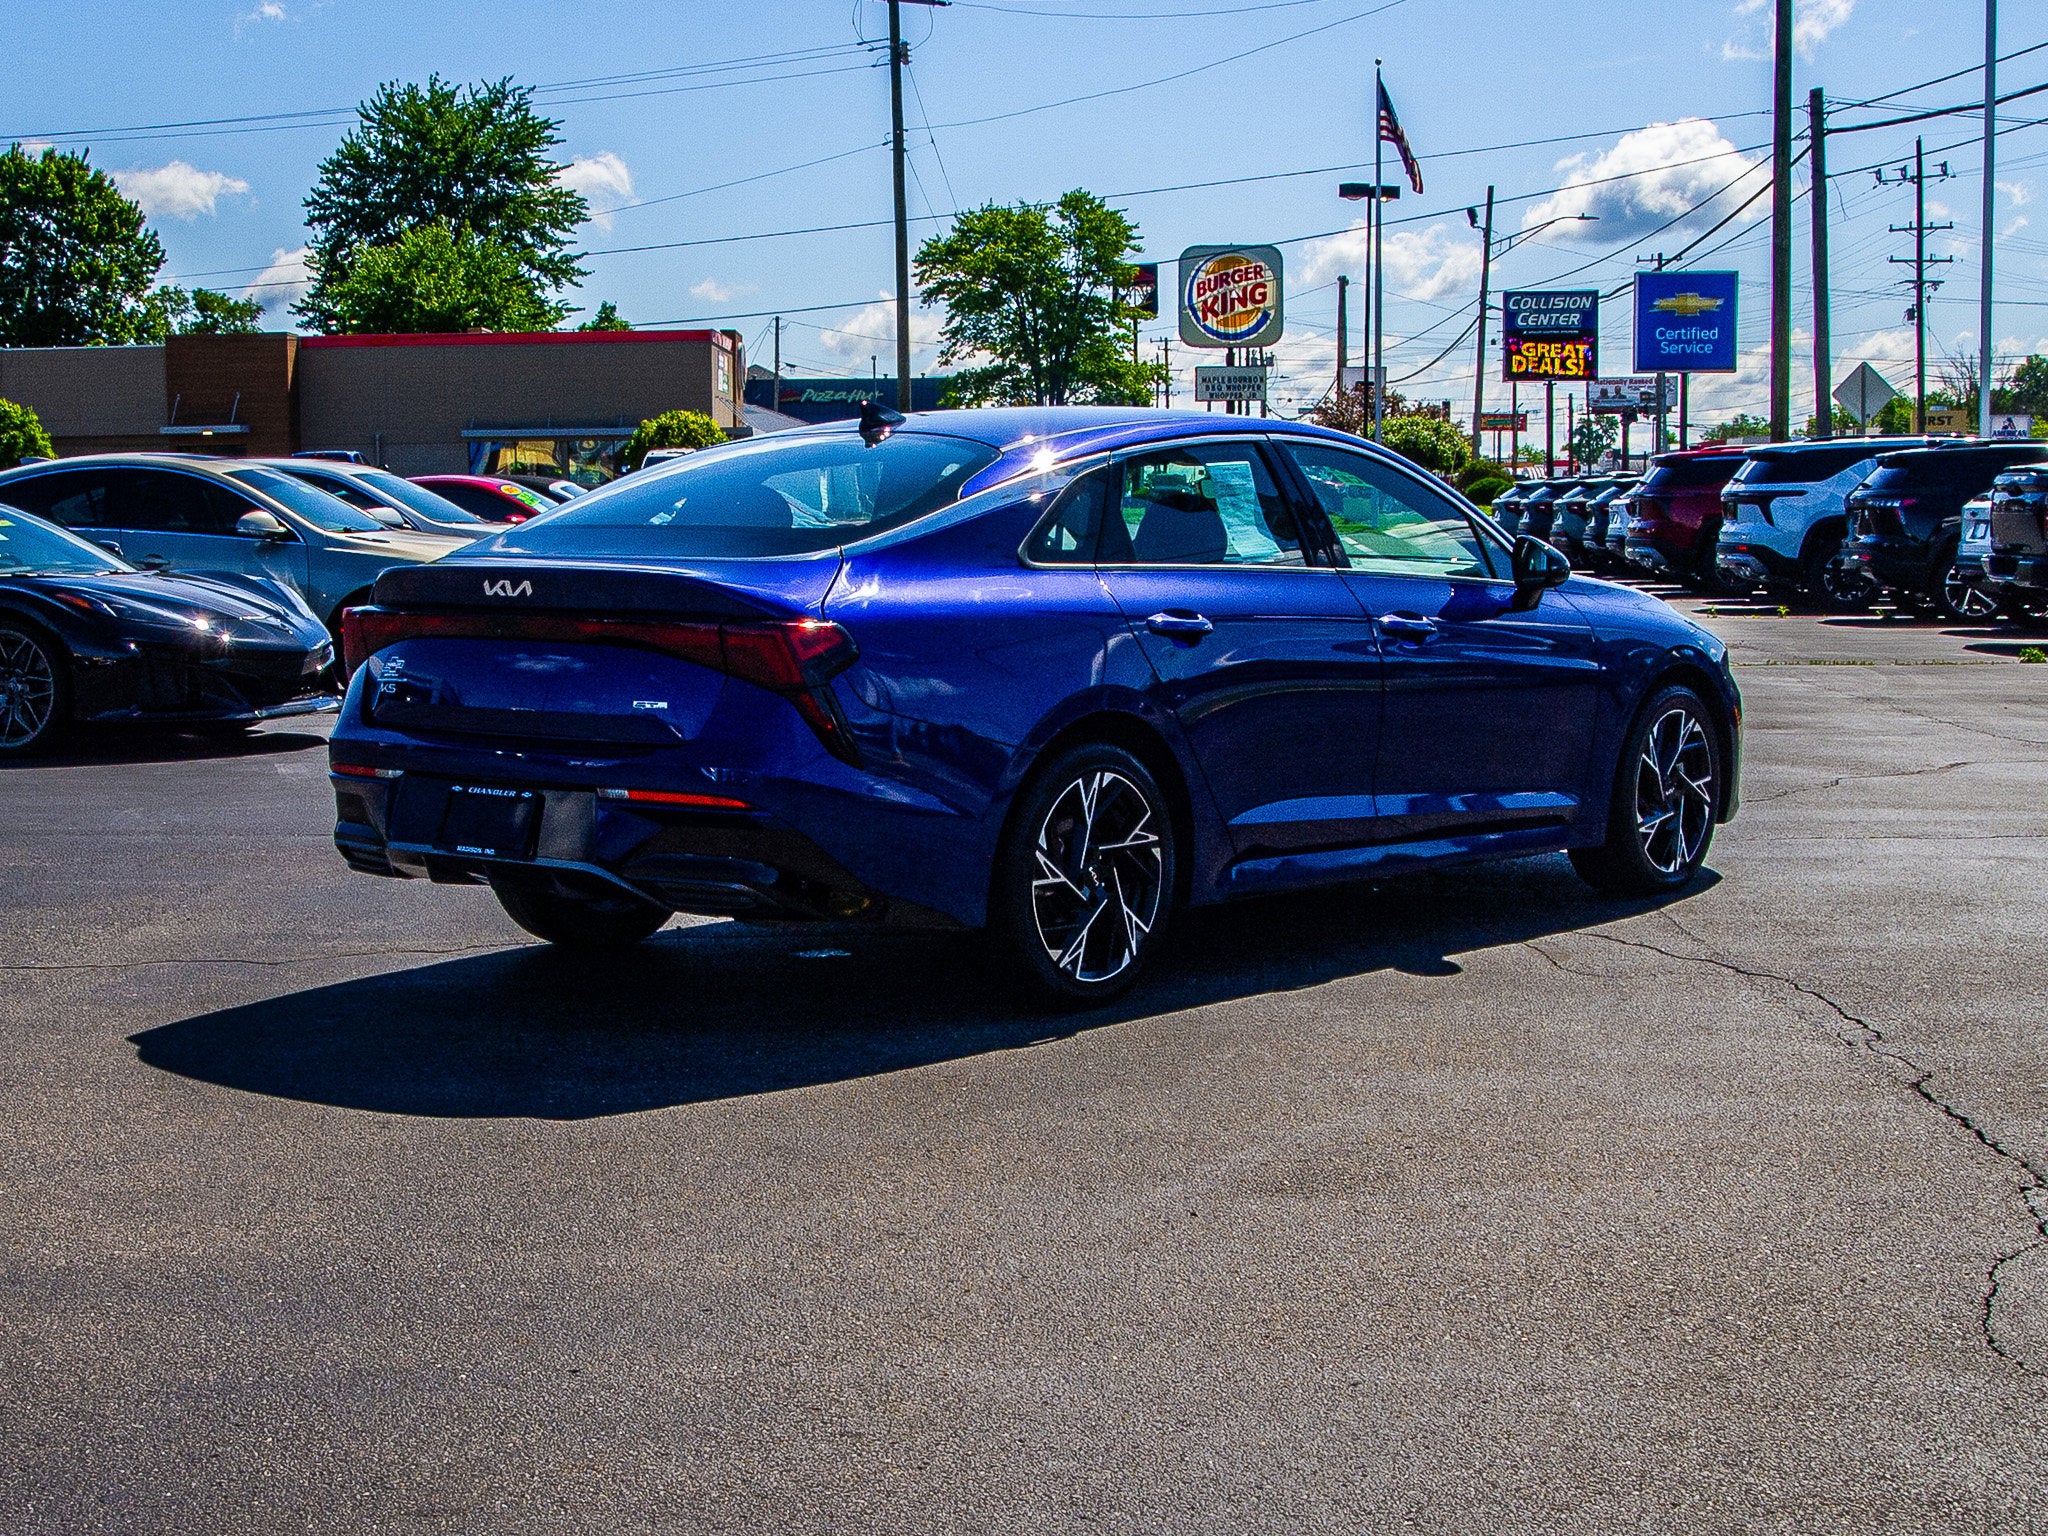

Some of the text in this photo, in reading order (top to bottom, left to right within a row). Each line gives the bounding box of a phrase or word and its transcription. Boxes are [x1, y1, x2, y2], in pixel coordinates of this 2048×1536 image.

[1197, 265, 1264, 299] BURGER
[1201, 282, 1267, 322] KING
[1509, 296, 1592, 310] COLLISION
[1517, 312, 1581, 326] CENTER
[1655, 327, 1719, 340] Certified
[1521, 342, 1590, 359] GREAT
[1660, 341, 1713, 354] Service
[1511, 355, 1585, 376] DEALS!
[1201, 375, 1226, 384] MAPLE
[801, 388, 848, 402] Pizza
[1208, 391, 1243, 399] WHOPPER
[483, 579, 533, 597] KIA
[380, 682, 397, 693] K5
[468, 787, 516, 796] CHANDLER
